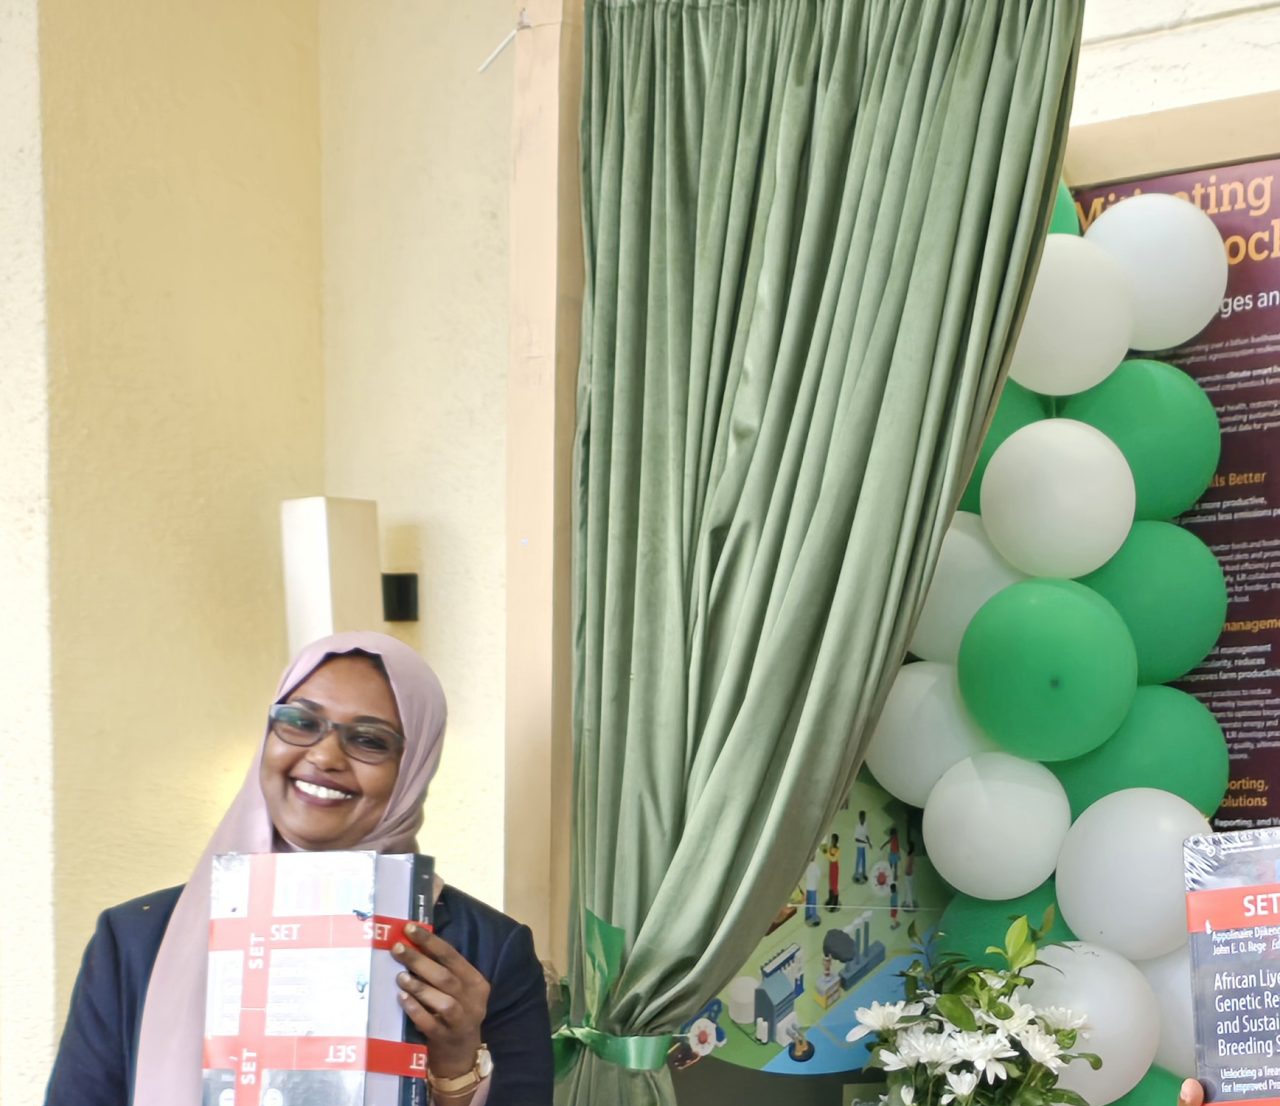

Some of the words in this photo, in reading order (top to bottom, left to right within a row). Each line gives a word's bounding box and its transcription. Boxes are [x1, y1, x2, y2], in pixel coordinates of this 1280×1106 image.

[1220, 294, 1253, 318] ges
[1228, 471, 1267, 487] Better
[1221, 794, 1268, 808] olutions
[270, 923, 301, 941] SET
[362, 923, 392, 941] SET
[248, 932, 265, 970] SET
[1214, 971, 1257, 991] African
[1215, 993, 1261, 1012] Genetic
[1217, 1015, 1240, 1034] and
[325, 1044, 357, 1063] SET
[1218, 1036, 1273, 1058] Breeding
[240, 1047, 257, 1086] SET
[1220, 1066, 1257, 1080] Unlocking
[1258, 1068, 1263, 1077] a
[1221, 1081, 1232, 1093] for
[1233, 1079, 1267, 1094] Improved
